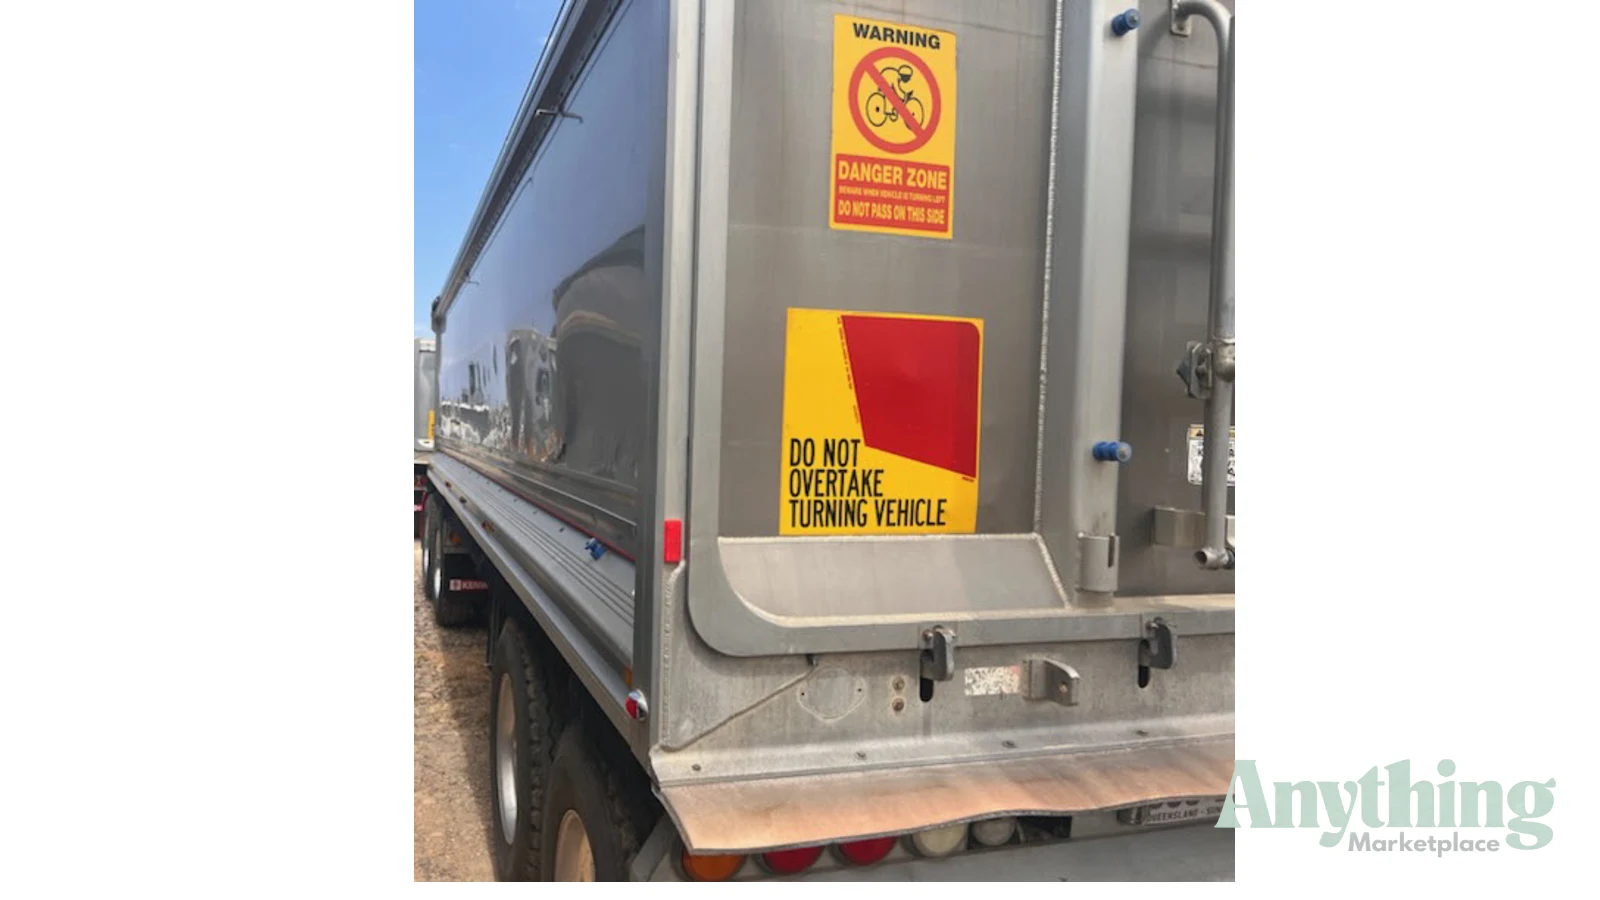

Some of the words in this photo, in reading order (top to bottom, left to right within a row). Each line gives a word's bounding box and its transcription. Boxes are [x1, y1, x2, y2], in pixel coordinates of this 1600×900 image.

[853, 22, 940, 50] WARNING
[838, 160, 903, 186] DANGER
[906, 167, 947, 190] ZONE
[838, 185, 861, 195] BEWARE
[862, 187, 879, 197] WHEN
[880, 189, 901, 199] VEHICLE
[902, 191, 908, 200] IS
[909, 193, 934, 202] TURNING
[935, 195, 946, 204] LEFT
[838, 199, 852, 216] DO
[852, 201, 871, 218] NOT
[871, 203, 893, 220] PASS
[893, 205, 906, 221] ON
[907, 206, 926, 223] THIS
[927, 208, 945, 225] SIDE
[789, 438, 815, 467] DO
[823, 438, 861, 467] NOT
[789, 469, 884, 497] OVERTAKE
[789, 499, 868, 528] TURNING
[874, 499, 947, 527] VEHICLE
[1146, 808, 1199, 822] QUEENSLAND
